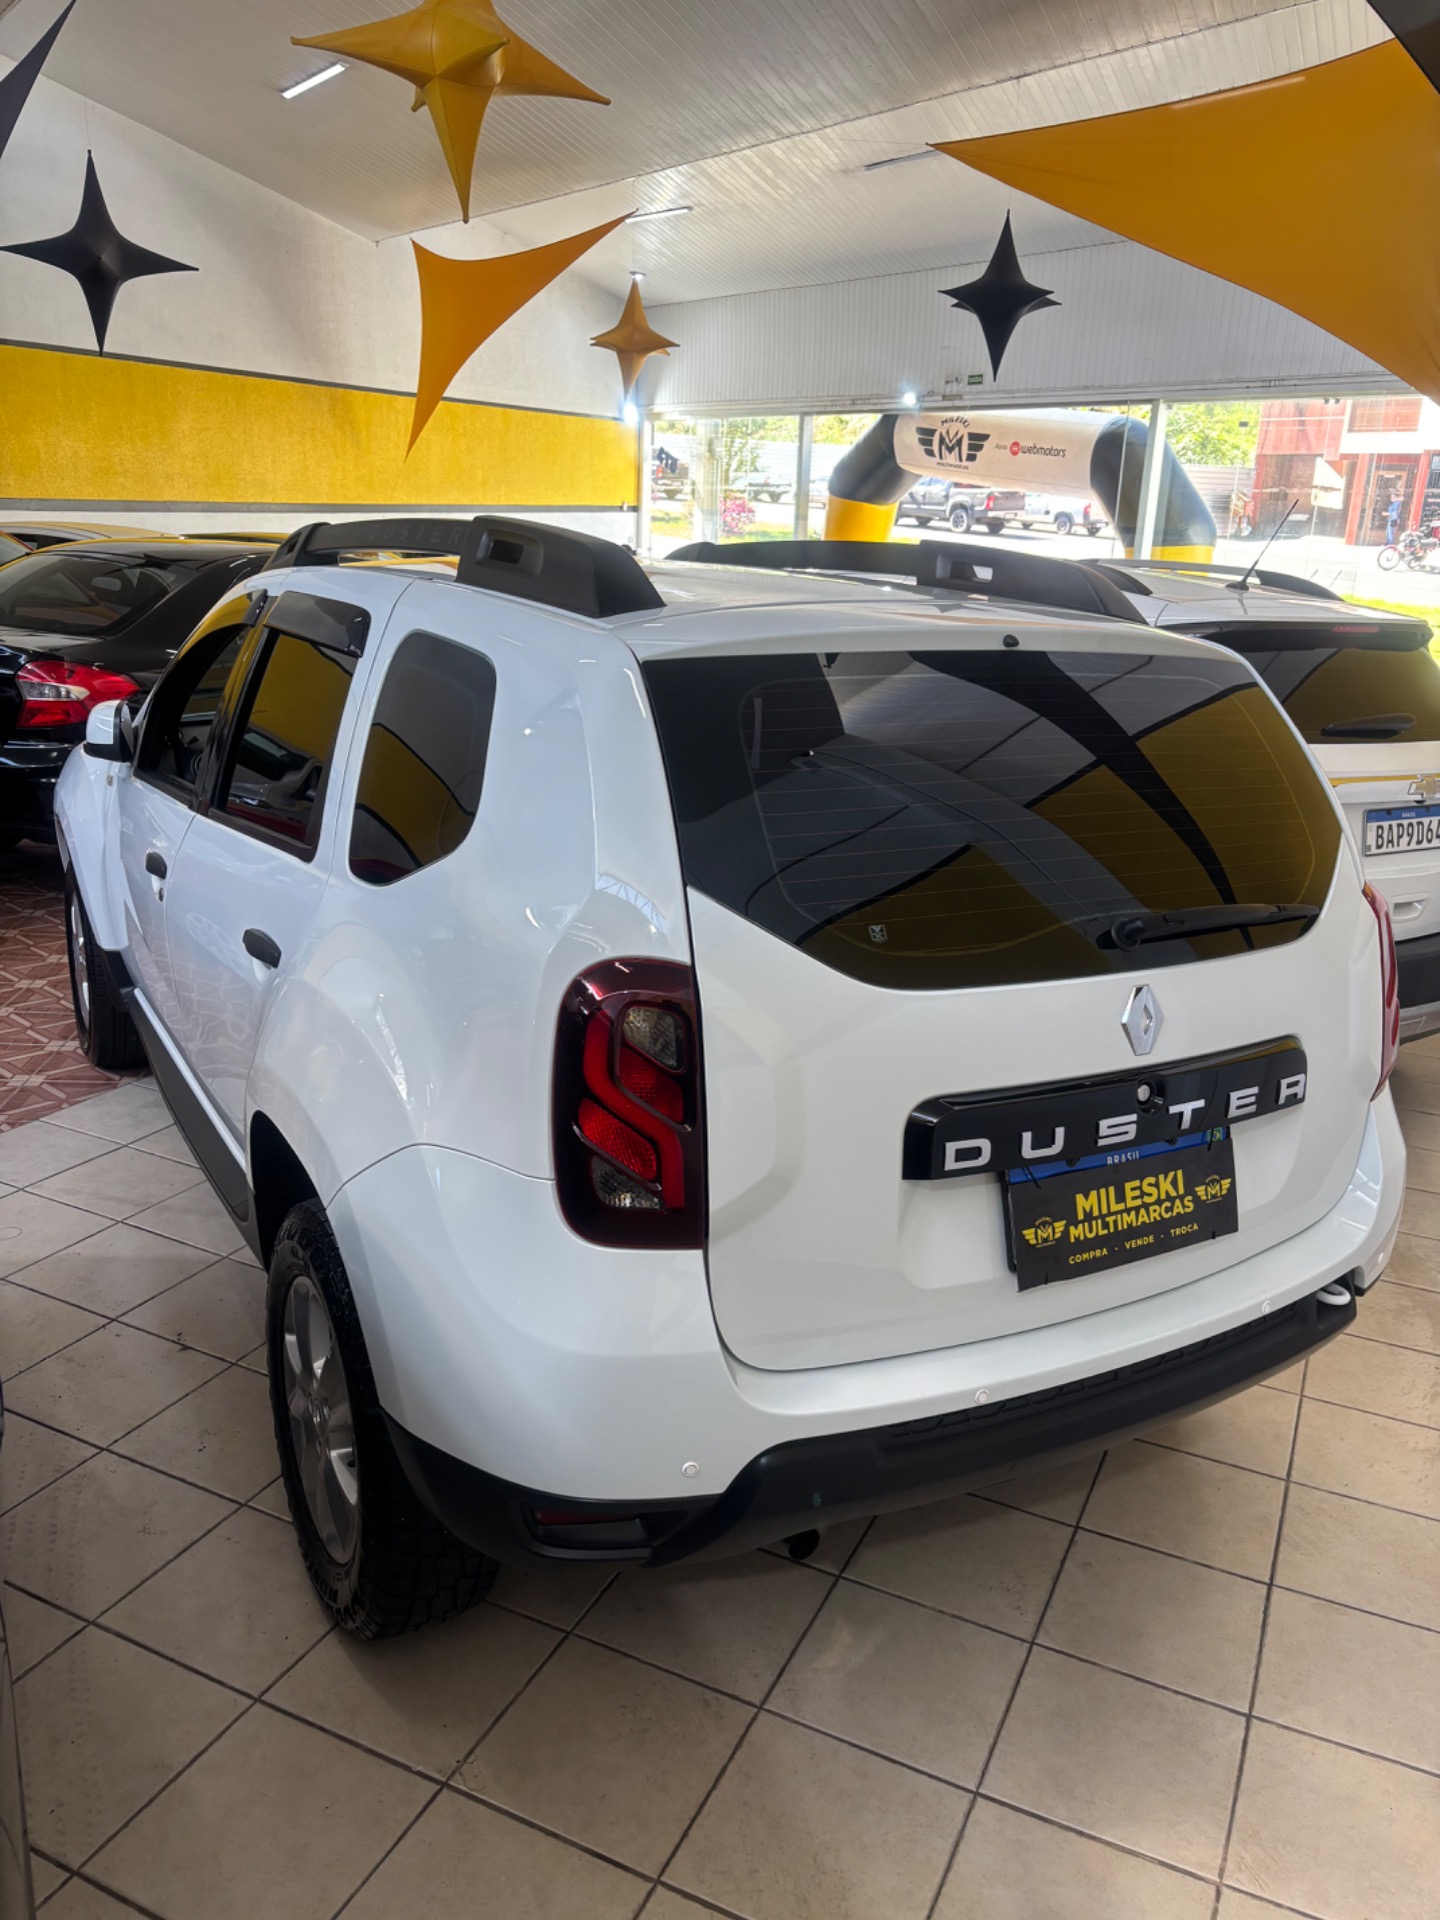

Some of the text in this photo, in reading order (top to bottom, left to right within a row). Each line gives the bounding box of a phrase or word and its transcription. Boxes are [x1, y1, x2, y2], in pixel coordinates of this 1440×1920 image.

[1021, 443, 1066, 458] webmotors
[368, 523, 464, 545] DUSTER
[944, 1073, 1307, 1170] DUSTER
[1075, 1168, 1185, 1221] MILESKI
[1069, 1195, 1195, 1243] MULTIMARCAS
[1068, 1247, 1109, 1265] COMPRA
[1124, 1234, 1155, 1250] VENDE
[1170, 1222, 1199, 1238] TROCA
